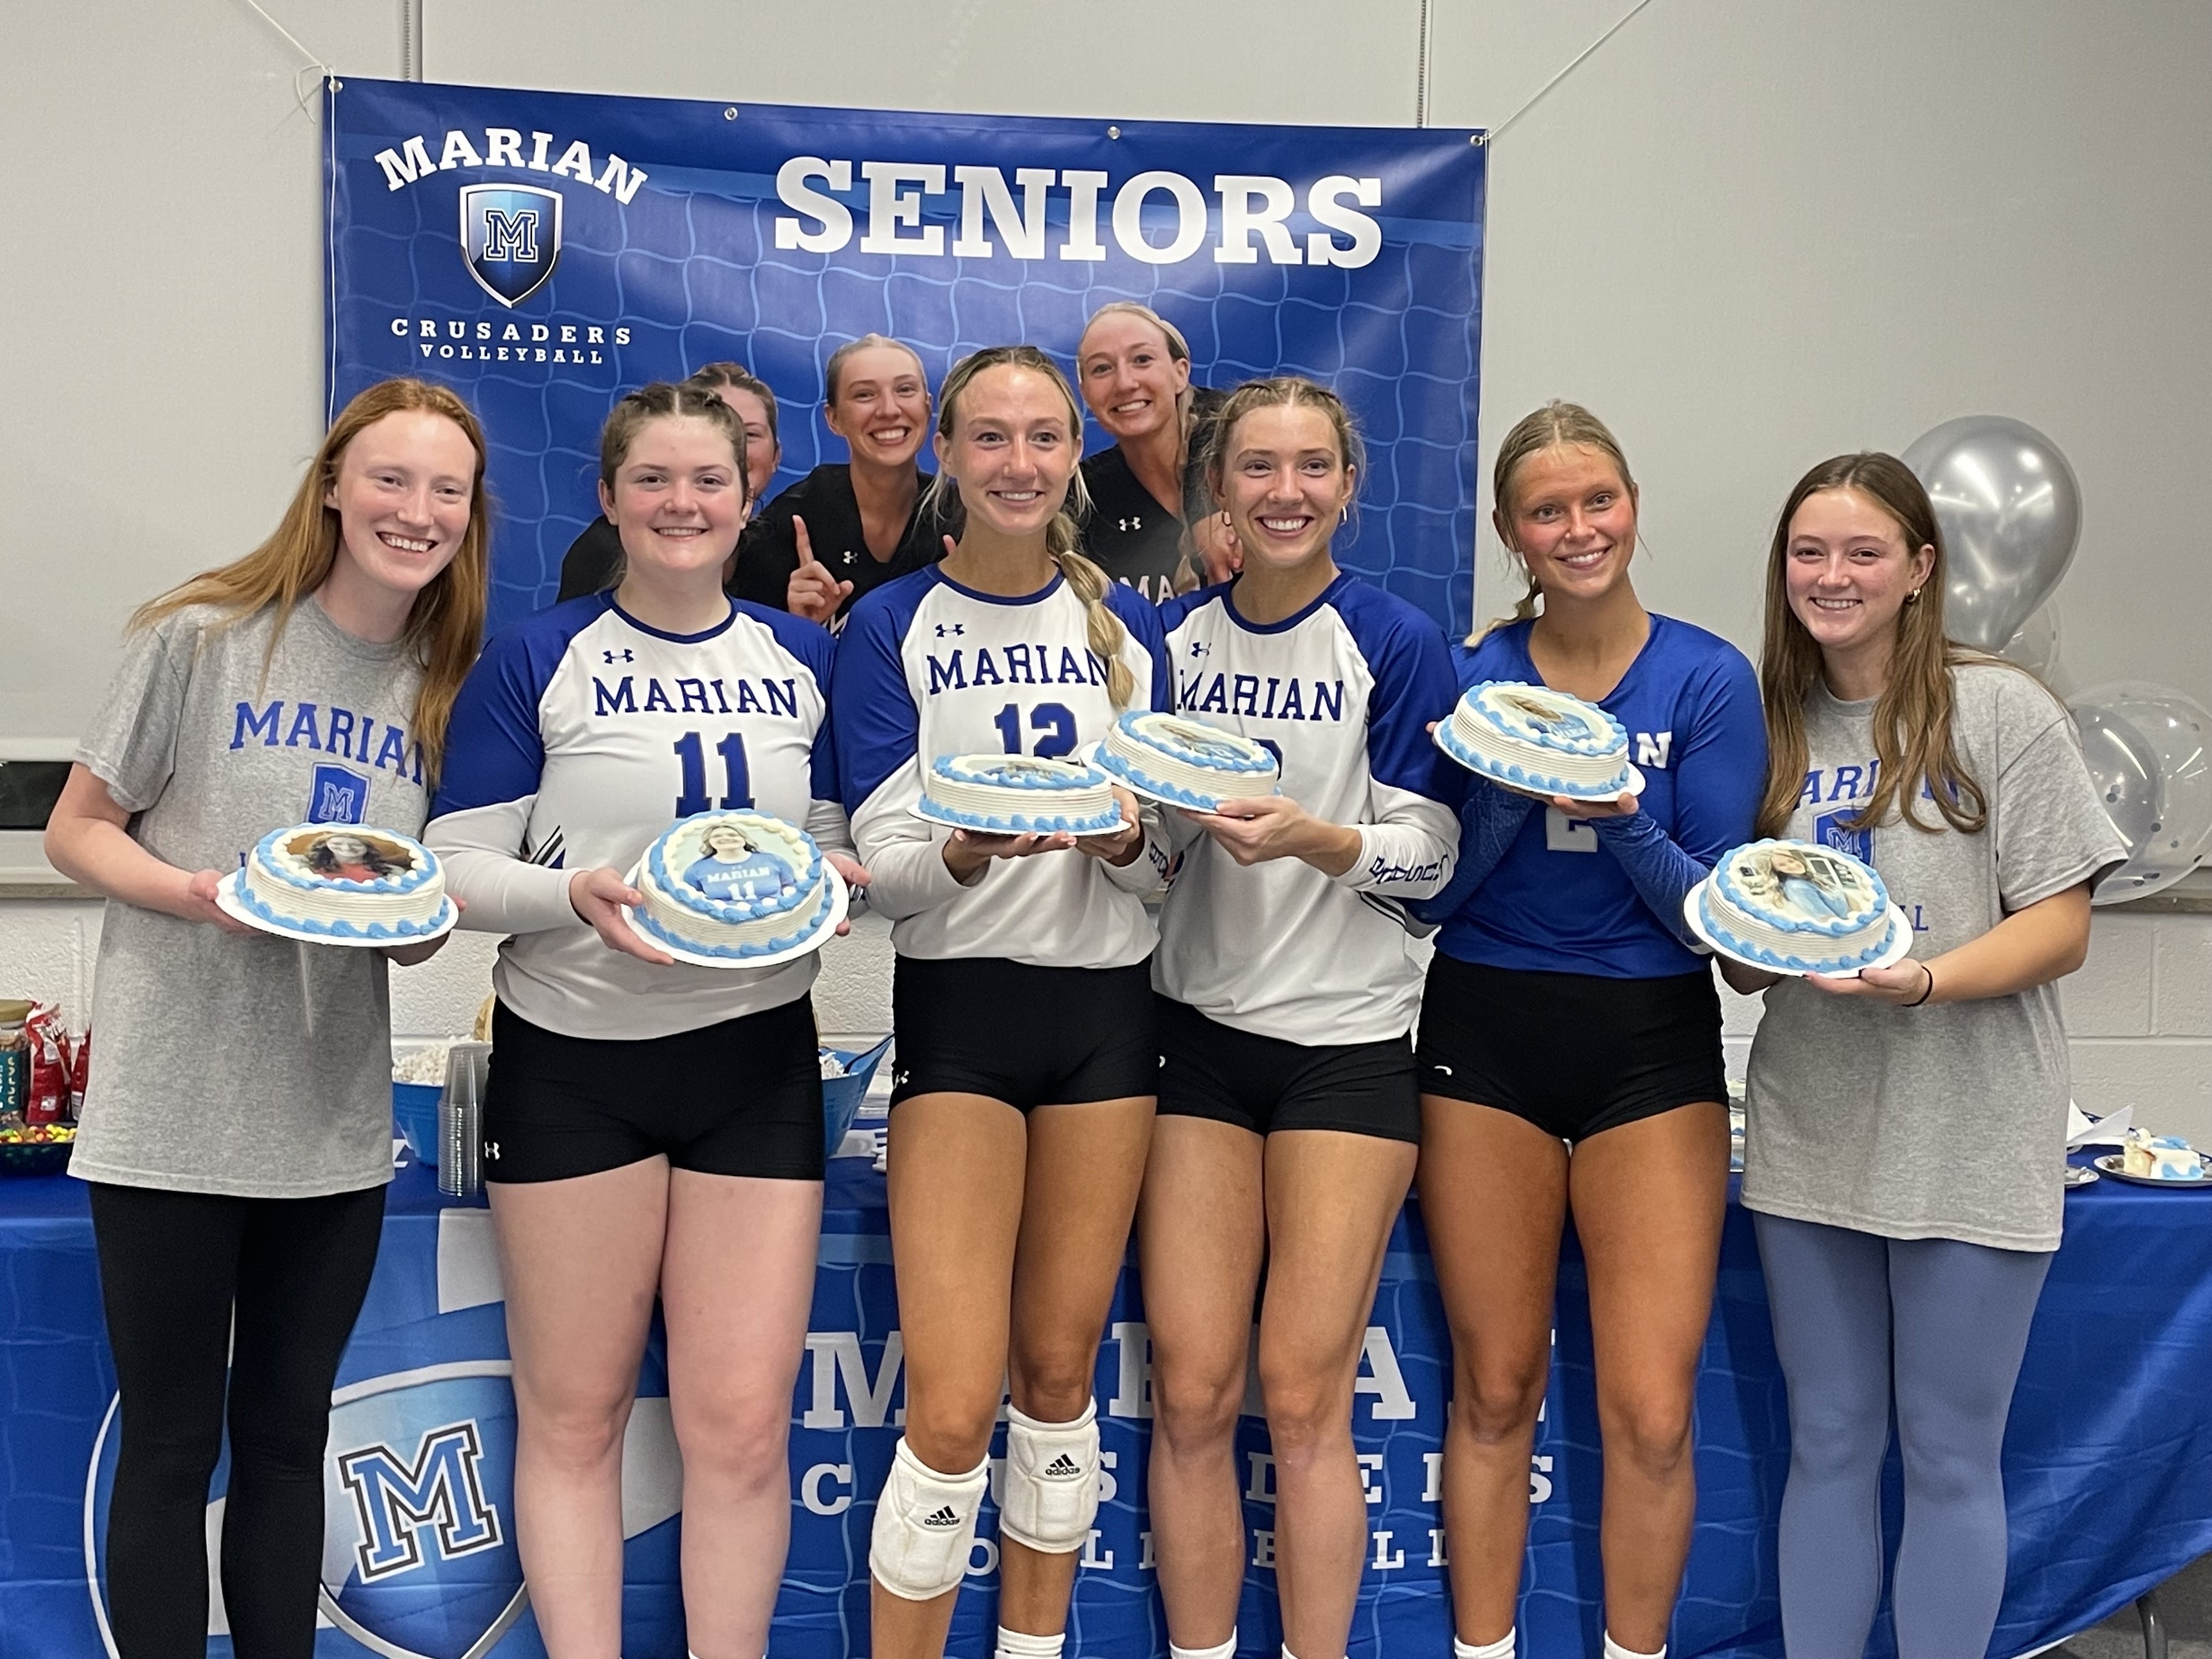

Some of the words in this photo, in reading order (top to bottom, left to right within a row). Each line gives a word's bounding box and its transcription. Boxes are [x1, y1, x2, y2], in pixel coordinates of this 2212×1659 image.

[374, 128, 648, 205] MARIAN
[483, 207, 538, 262] M
[775, 156, 1382, 269] SENIORS
[391, 319, 631, 345] CRUSADERS
[421, 344, 602, 364] VOLLEYBALL
[592, 676, 799, 718] MARIAN
[994, 703, 1079, 764] 12
[674, 731, 755, 818] 11
[707, 867, 770, 883] MARIAN
[728, 881, 757, 901] 11
[335, 1417, 504, 1585] M
